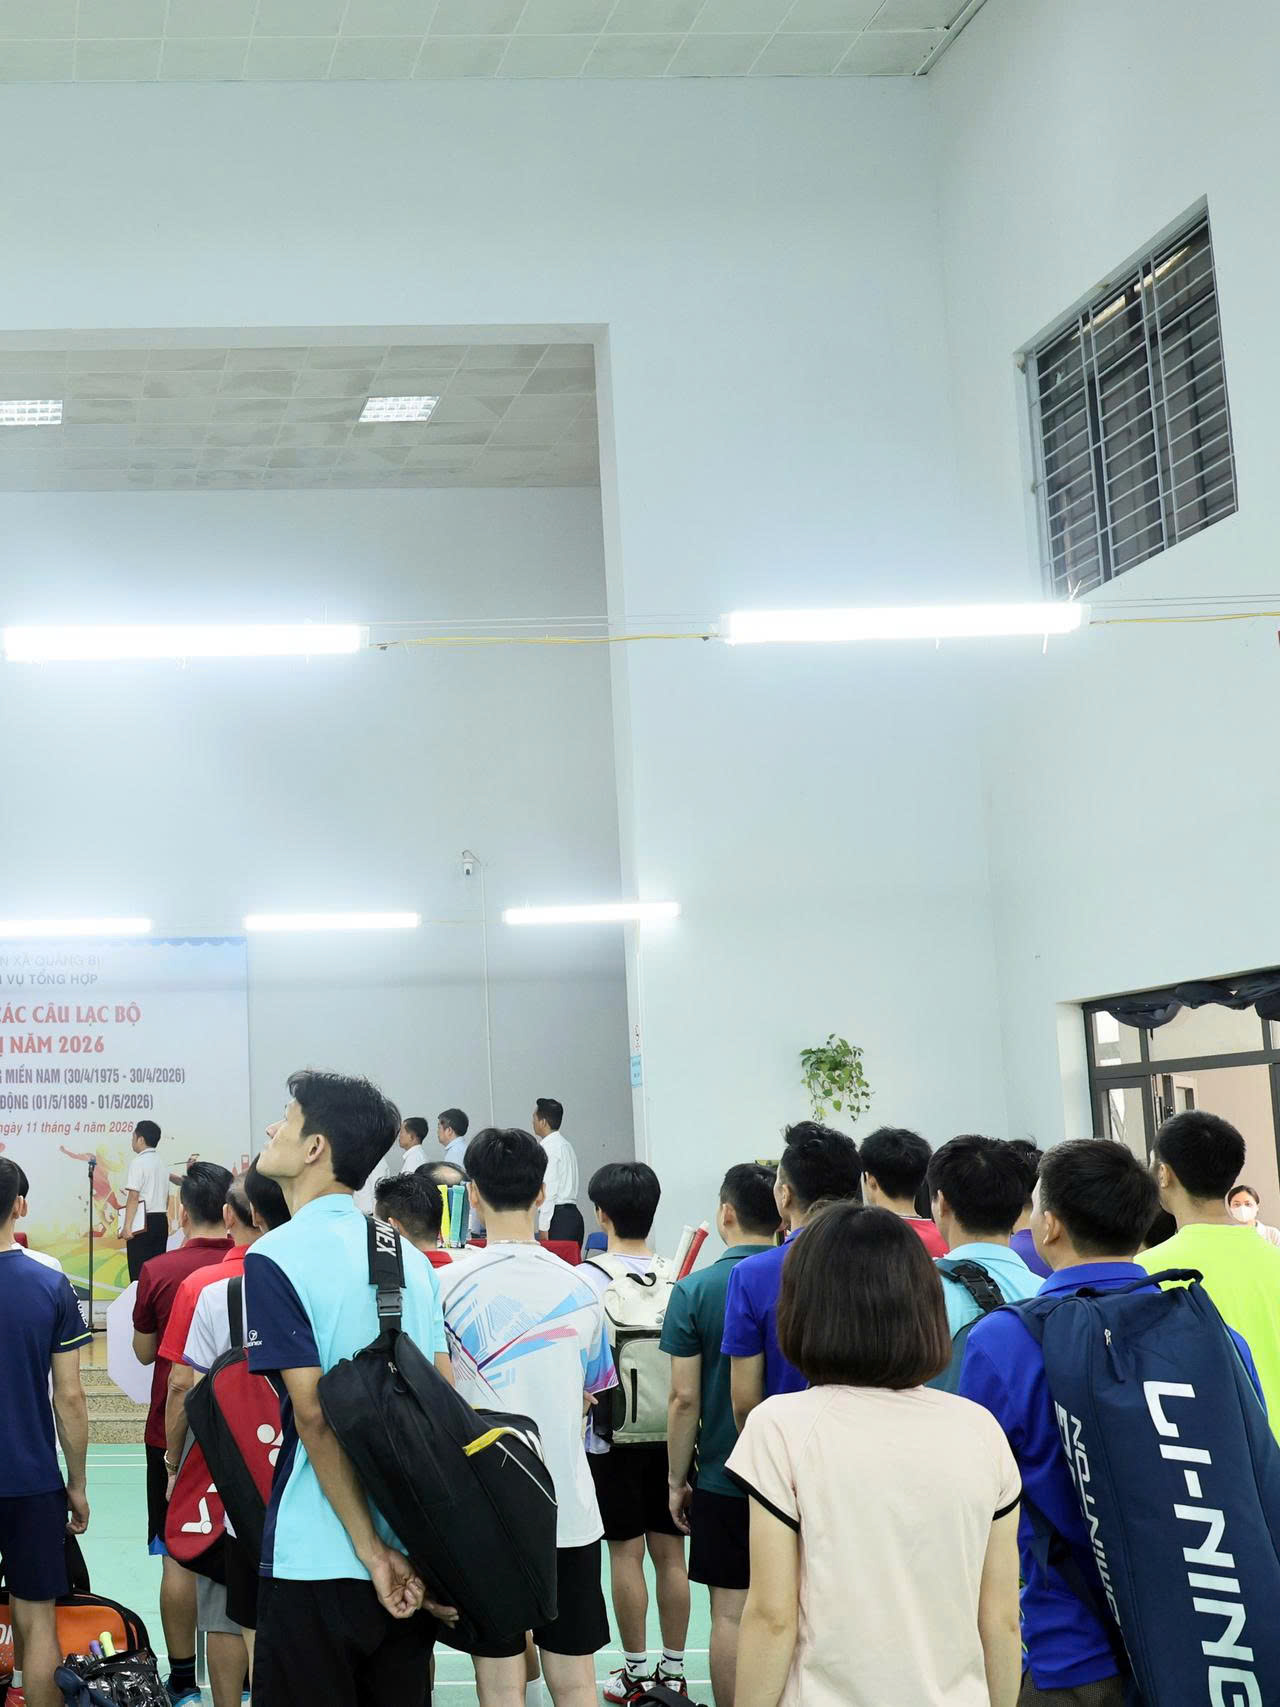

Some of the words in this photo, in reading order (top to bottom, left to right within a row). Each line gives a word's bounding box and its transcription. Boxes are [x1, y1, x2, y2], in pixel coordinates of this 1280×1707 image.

[7, 974, 24, 988] VỤ
[30, 968, 66, 985] TỔNG
[70, 973, 99, 988] HỢP
[32, 1001, 69, 1024] CÂU
[76, 1006, 108, 1026] LẠC
[115, 1002, 141, 1026] BỘ
[10, 1033, 52, 1054] NĂM
[59, 1036, 105, 1053] 2026
[36, 1069, 60, 1083] NAM
[64, 1068, 119, 1084] (30/4/1975
[130, 1068, 185, 1083] 30/4/2026)
[0, 1092, 28, 1112] ĐỘNG
[32, 1094, 88, 1109] (01/5/1889
[98, 1094, 153, 1109] 01/5/2026)
[26, 1122, 37, 1132] 11
[41, 1121, 71, 1135] tháng
[74, 1122, 80, 1132] 4
[83, 1121, 106, 1132] năm
[109, 1121, 134, 1132] 2026
[373, 1217, 397, 1257] NEX
[1143, 1378, 1263, 1707] LI-NING
